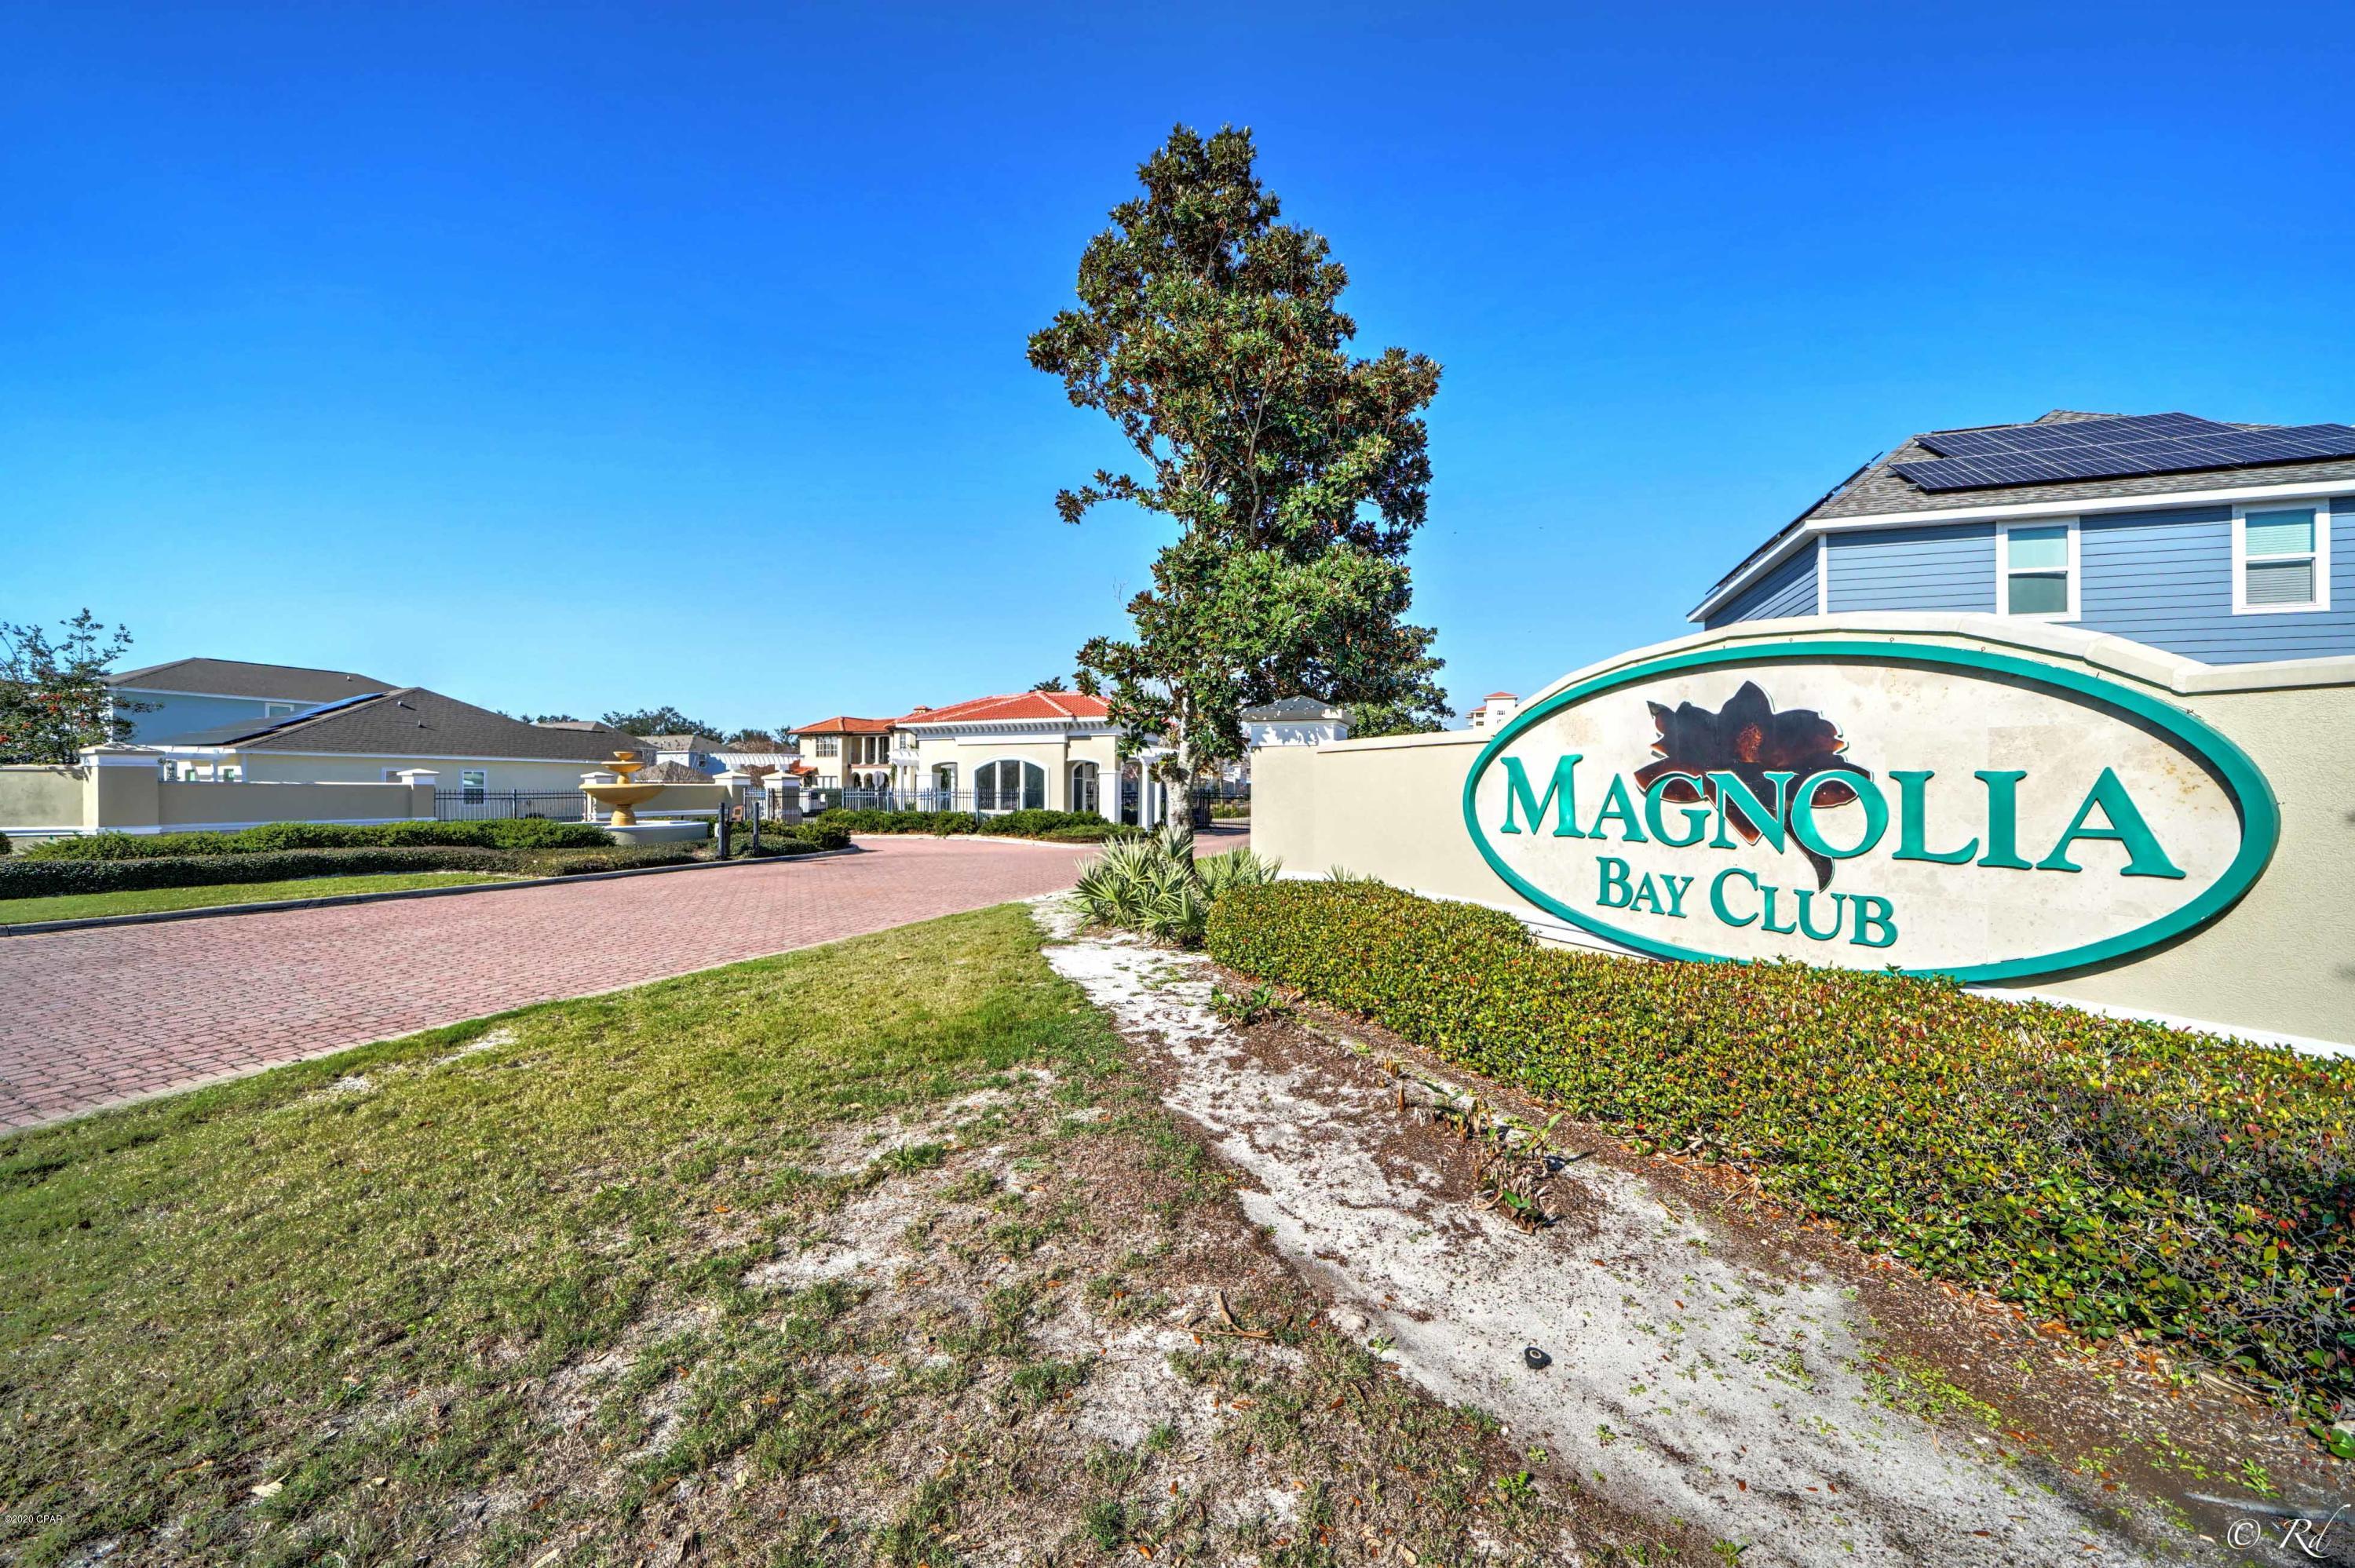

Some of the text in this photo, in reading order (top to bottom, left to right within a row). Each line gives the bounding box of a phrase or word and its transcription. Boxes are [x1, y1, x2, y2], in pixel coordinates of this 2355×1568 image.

[1500, 753, 2187, 879] MAGNOLIA
[1595, 856, 1898, 948] BAY CLUB
